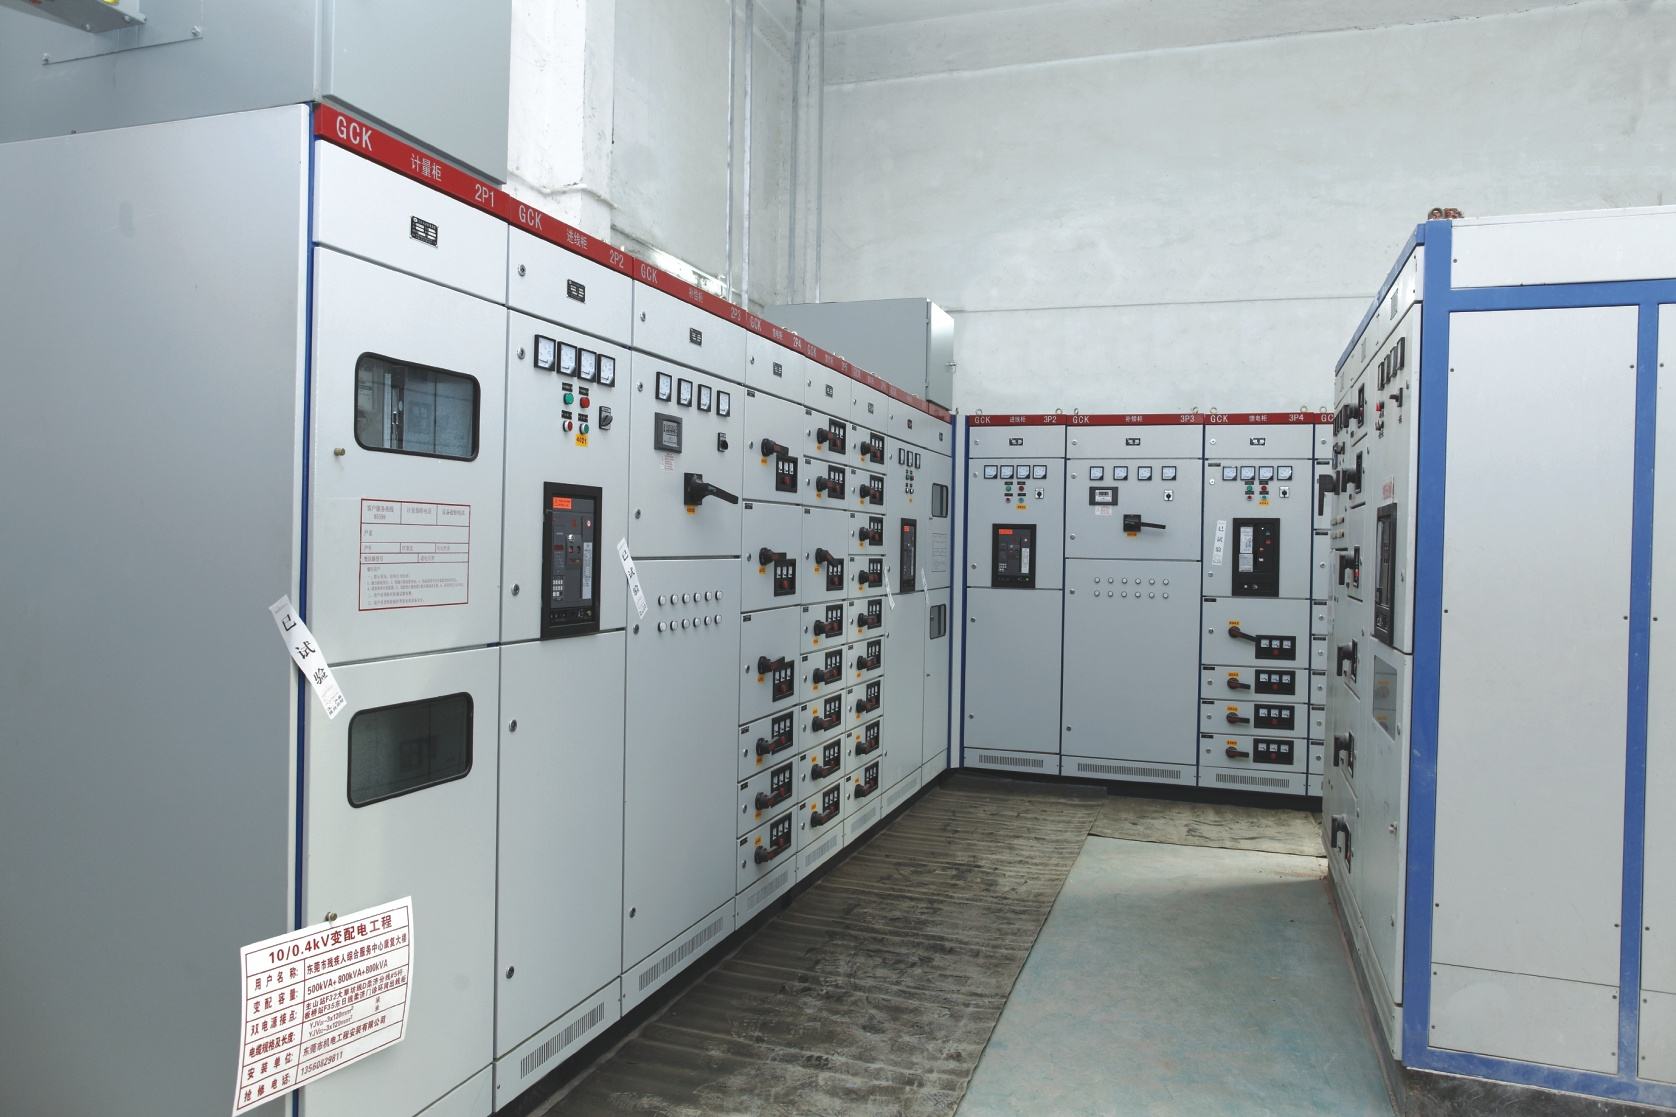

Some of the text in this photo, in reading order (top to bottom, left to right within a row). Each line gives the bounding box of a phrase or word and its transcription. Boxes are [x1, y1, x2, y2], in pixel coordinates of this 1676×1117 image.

[336, 116, 372, 151] GCK
[410, 154, 442, 181] 计量柜
[475, 185, 495, 207] 2P1
[518, 205, 542, 230] GCK
[566, 228, 588, 250] 进线柜
[609, 250, 624, 268] 2P2
[640, 264, 658, 283] GCK
[750, 316, 762, 331] GCK
[1072, 416, 1090, 424] GCK
[282, 614, 328, 685] 已试验
[269, 914, 393, 963] 10/0.4kV变配电工程
